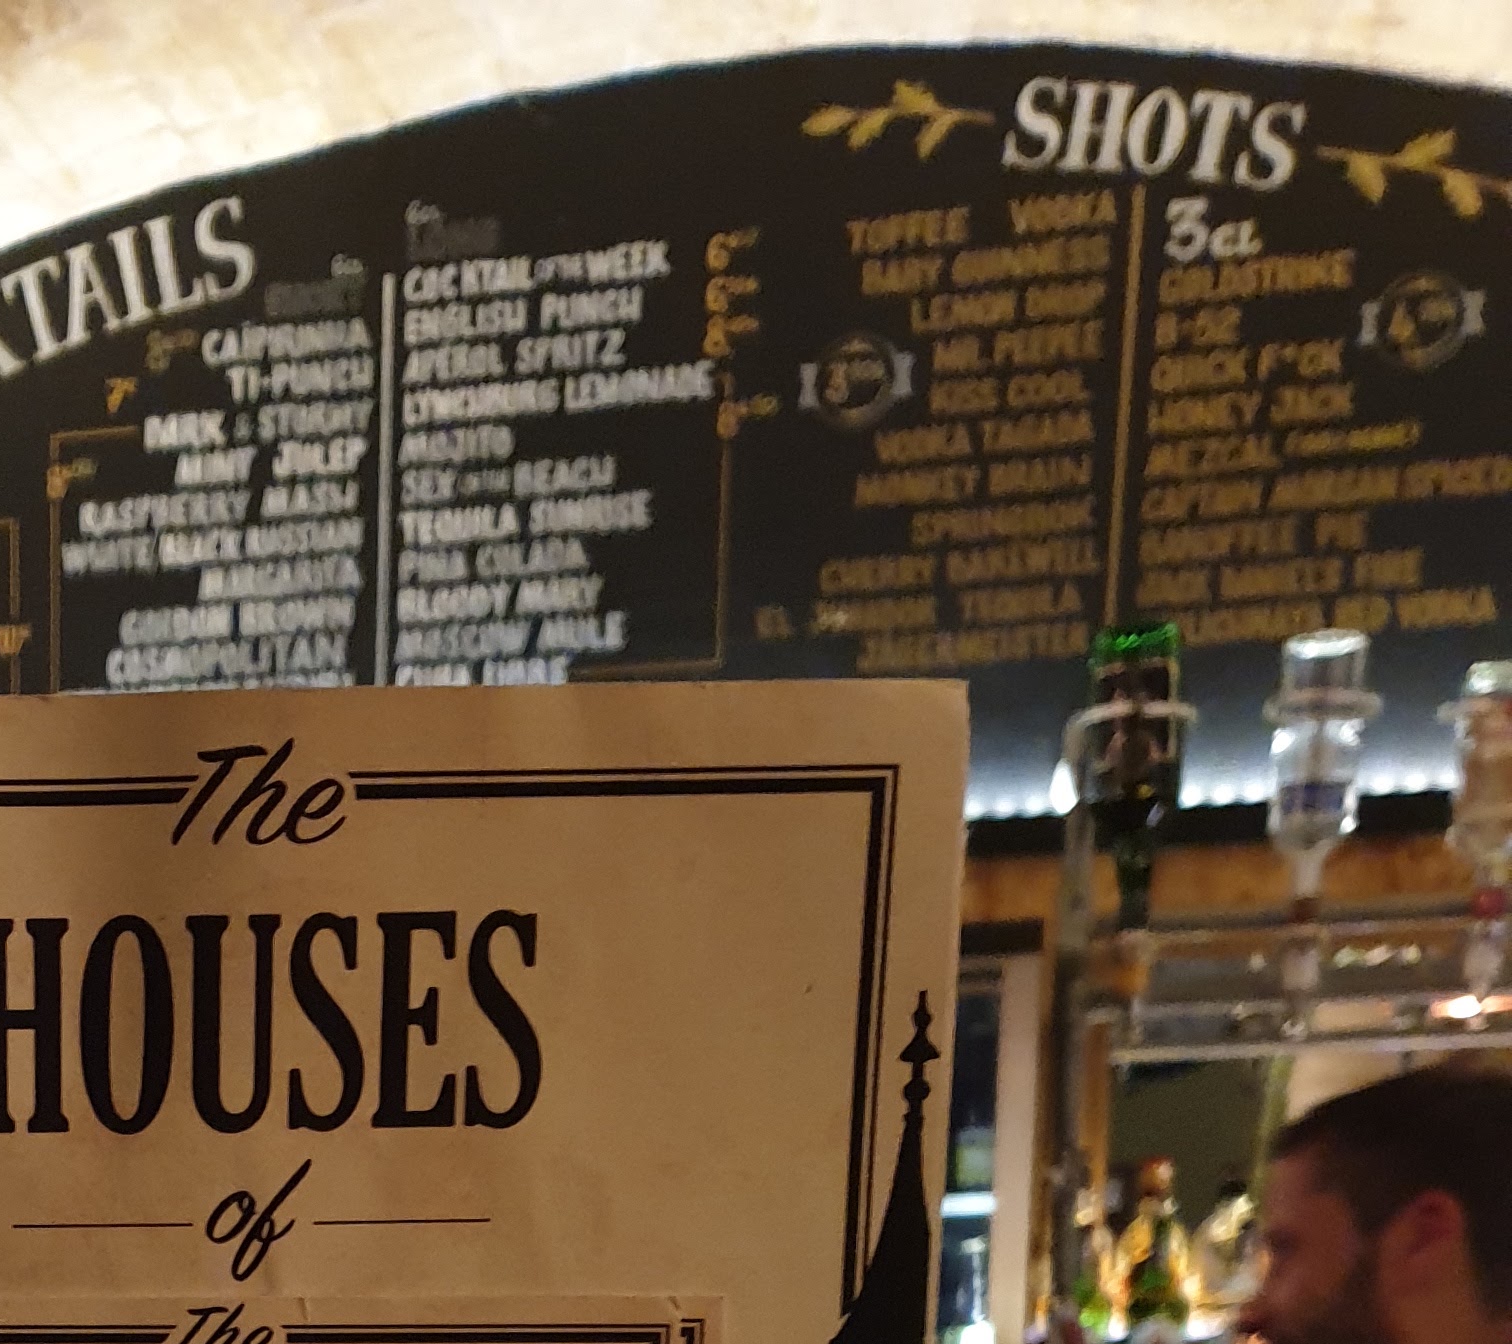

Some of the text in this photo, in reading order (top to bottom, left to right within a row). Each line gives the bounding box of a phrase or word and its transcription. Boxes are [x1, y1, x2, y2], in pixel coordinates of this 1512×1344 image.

[1002, 75, 1306, 193] SHOTS
[172, 738, 346, 846] The
[206, 1159, 312, 1281] of
